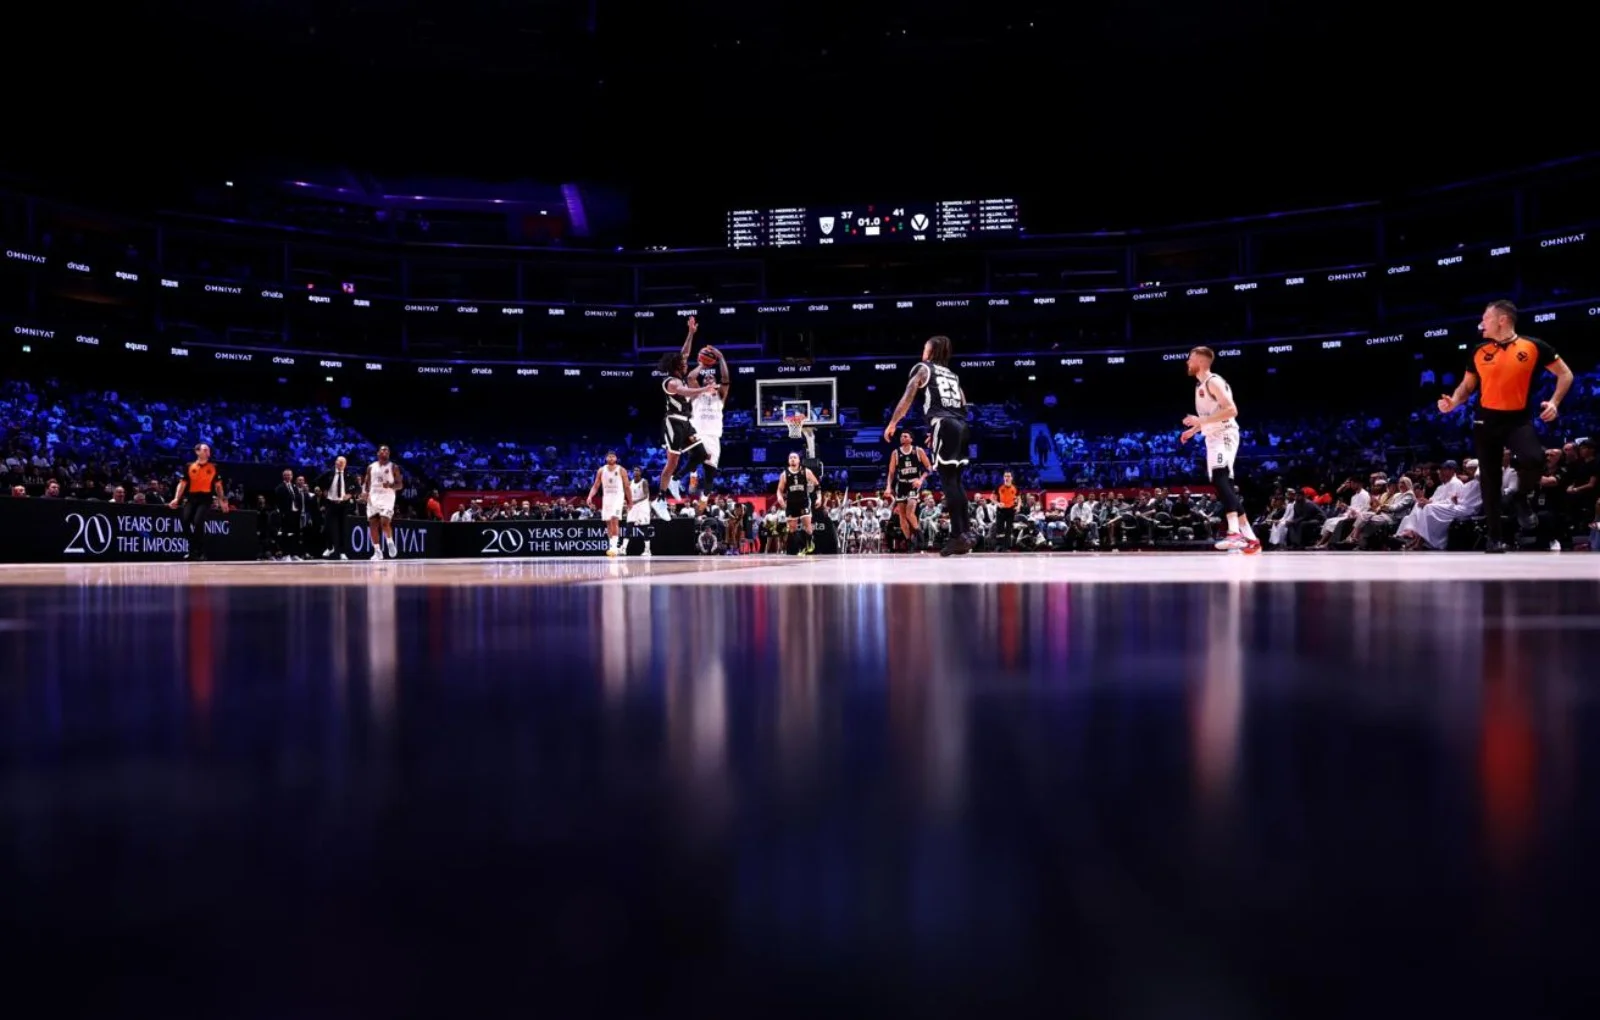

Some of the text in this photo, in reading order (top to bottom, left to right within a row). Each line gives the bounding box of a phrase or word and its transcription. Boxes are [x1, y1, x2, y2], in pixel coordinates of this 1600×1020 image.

[841, 211, 853, 219] 37
[892, 208, 904, 216] 41
[857, 217, 880, 227] 01.0
[6, 250, 46, 264] OMNIYAT
[66, 261, 90, 273] dnata
[204, 284, 242, 294] OMNIYAT
[261, 290, 284, 299] dnata
[404, 304, 439, 312] OMNIYAT
[456, 305, 479, 313] dnata
[757, 305, 791, 313] OMNIYAT
[807, 304, 829, 312] dnata
[935, 299, 970, 307] OMNIYAT
[987, 298, 1010, 306] dnata
[1132, 291, 1168, 301] OMNIYAT
[1186, 287, 1209, 296] dnata
[1327, 271, 1367, 282] OMNIYAT
[1387, 265, 1411, 275] dnata
[1540, 233, 1585, 248] OMNIYAT
[14, 326, 55, 339] OMNIYAT
[75, 334, 100, 345] dnata
[214, 351, 253, 361] OMNIYAT
[272, 356, 295, 365] dnata
[417, 366, 453, 374] OMNIYAT
[471, 367, 493, 375] dnata
[829, 363, 851, 372] dnata
[960, 360, 996, 368] OMNIYAT
[1013, 359, 1036, 367] dnata
[1162, 351, 1190, 361] OMNIY
[1218, 348, 1242, 357] dnata
[1365, 333, 1404, 345] OMNIYAT
[1423, 328, 1449, 338] dnata
[936, 376, 961, 401] 23
[117, 515, 152, 532] YEARS
[155, 516, 171, 533] OF
[528, 528, 564, 538] YEARS
[566, 527, 584, 538] OF
[63, 513, 112, 554] 20
[481, 528, 524, 553] 20
[117, 536, 189, 553] THE IMPOSSI
[528, 541, 611, 551] THE IMPOSSIB
